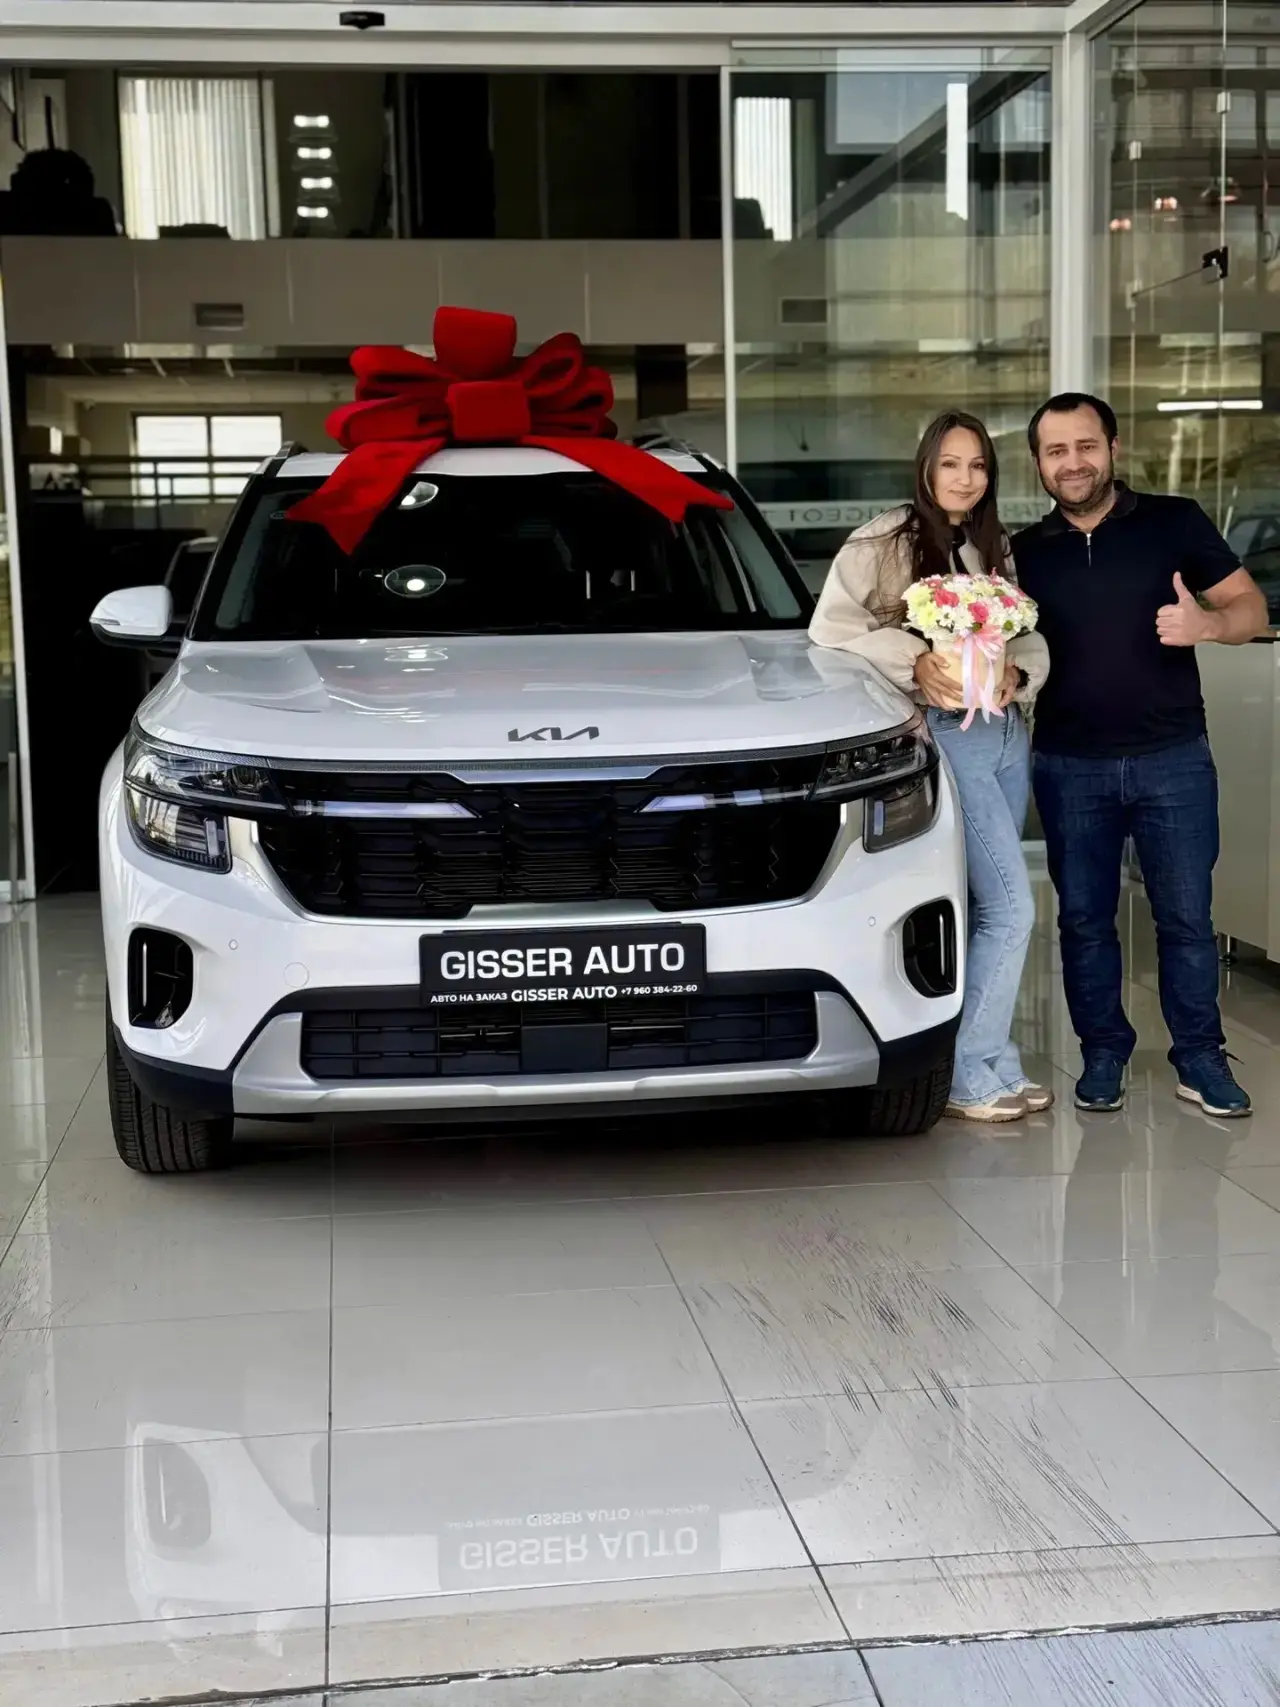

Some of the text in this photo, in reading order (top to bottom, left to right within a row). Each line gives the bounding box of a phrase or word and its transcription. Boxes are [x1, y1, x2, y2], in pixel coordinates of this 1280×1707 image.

[440, 942, 685, 980] GISSER AUTO
[430, 984, 698, 1003] АВТО НА ЗАКАЗ GISSER AUTO +7 960 384-22-60
